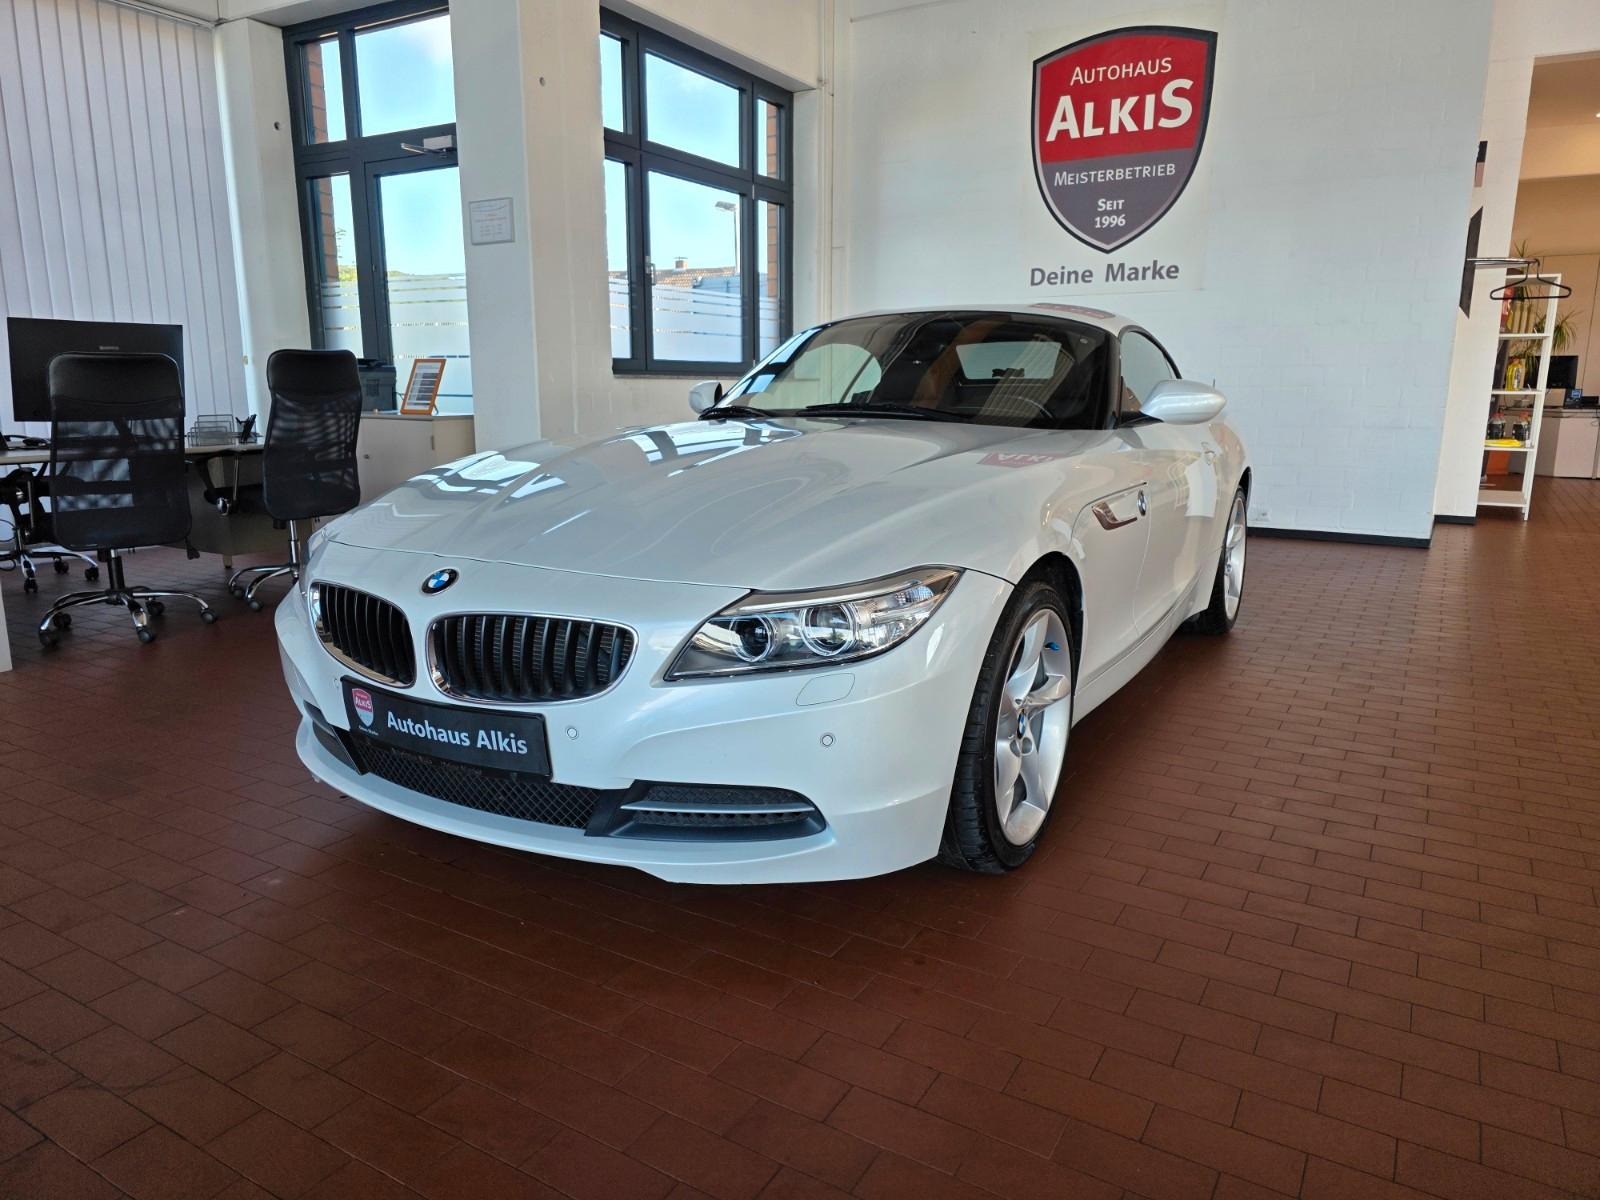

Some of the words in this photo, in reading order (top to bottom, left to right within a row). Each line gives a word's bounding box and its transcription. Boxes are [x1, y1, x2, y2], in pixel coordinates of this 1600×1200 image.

[1070, 57, 1172, 86] AUTOHAUS
[1046, 78, 1194, 142] ALKIS
[1054, 163, 1176, 186] MEISTERBETRIEB
[1097, 198, 1124, 211] SEIT
[1094, 214, 1126, 228] 1996
[1030, 265, 1093, 287] Deine
[1104, 259, 1180, 283] Marke
[387, 711, 471, 747] Autohaus
[476, 729, 528, 755] Alkis
